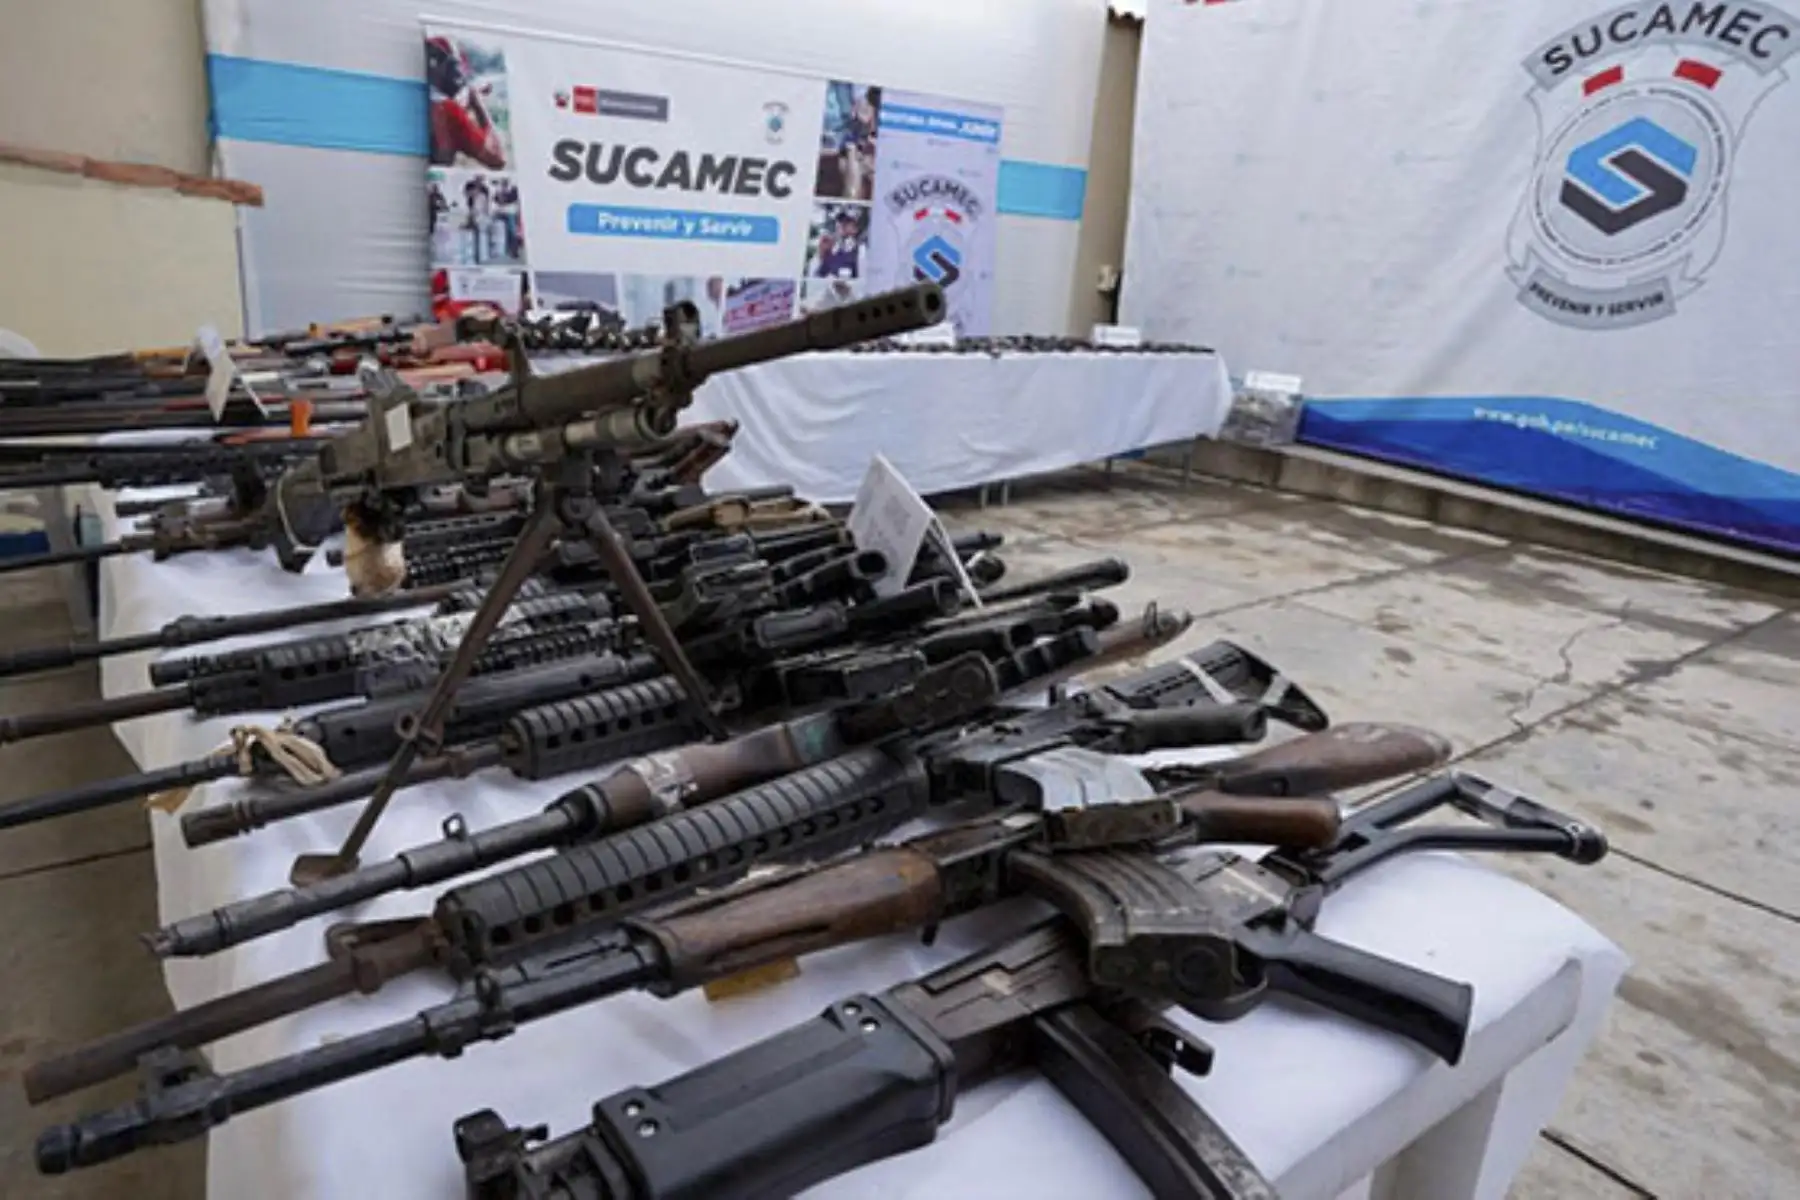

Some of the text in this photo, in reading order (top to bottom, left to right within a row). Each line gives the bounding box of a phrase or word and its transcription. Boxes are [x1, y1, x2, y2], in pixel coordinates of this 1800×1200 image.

[1542, 2, 1790, 75] SUCAMEC
[548, 139, 796, 199] SUCAMEC
[893, 179, 979, 216] SUCAMEC
[598, 210, 753, 237] Prevenir y Servir
[1529, 281, 1592, 316] PREVENIR
